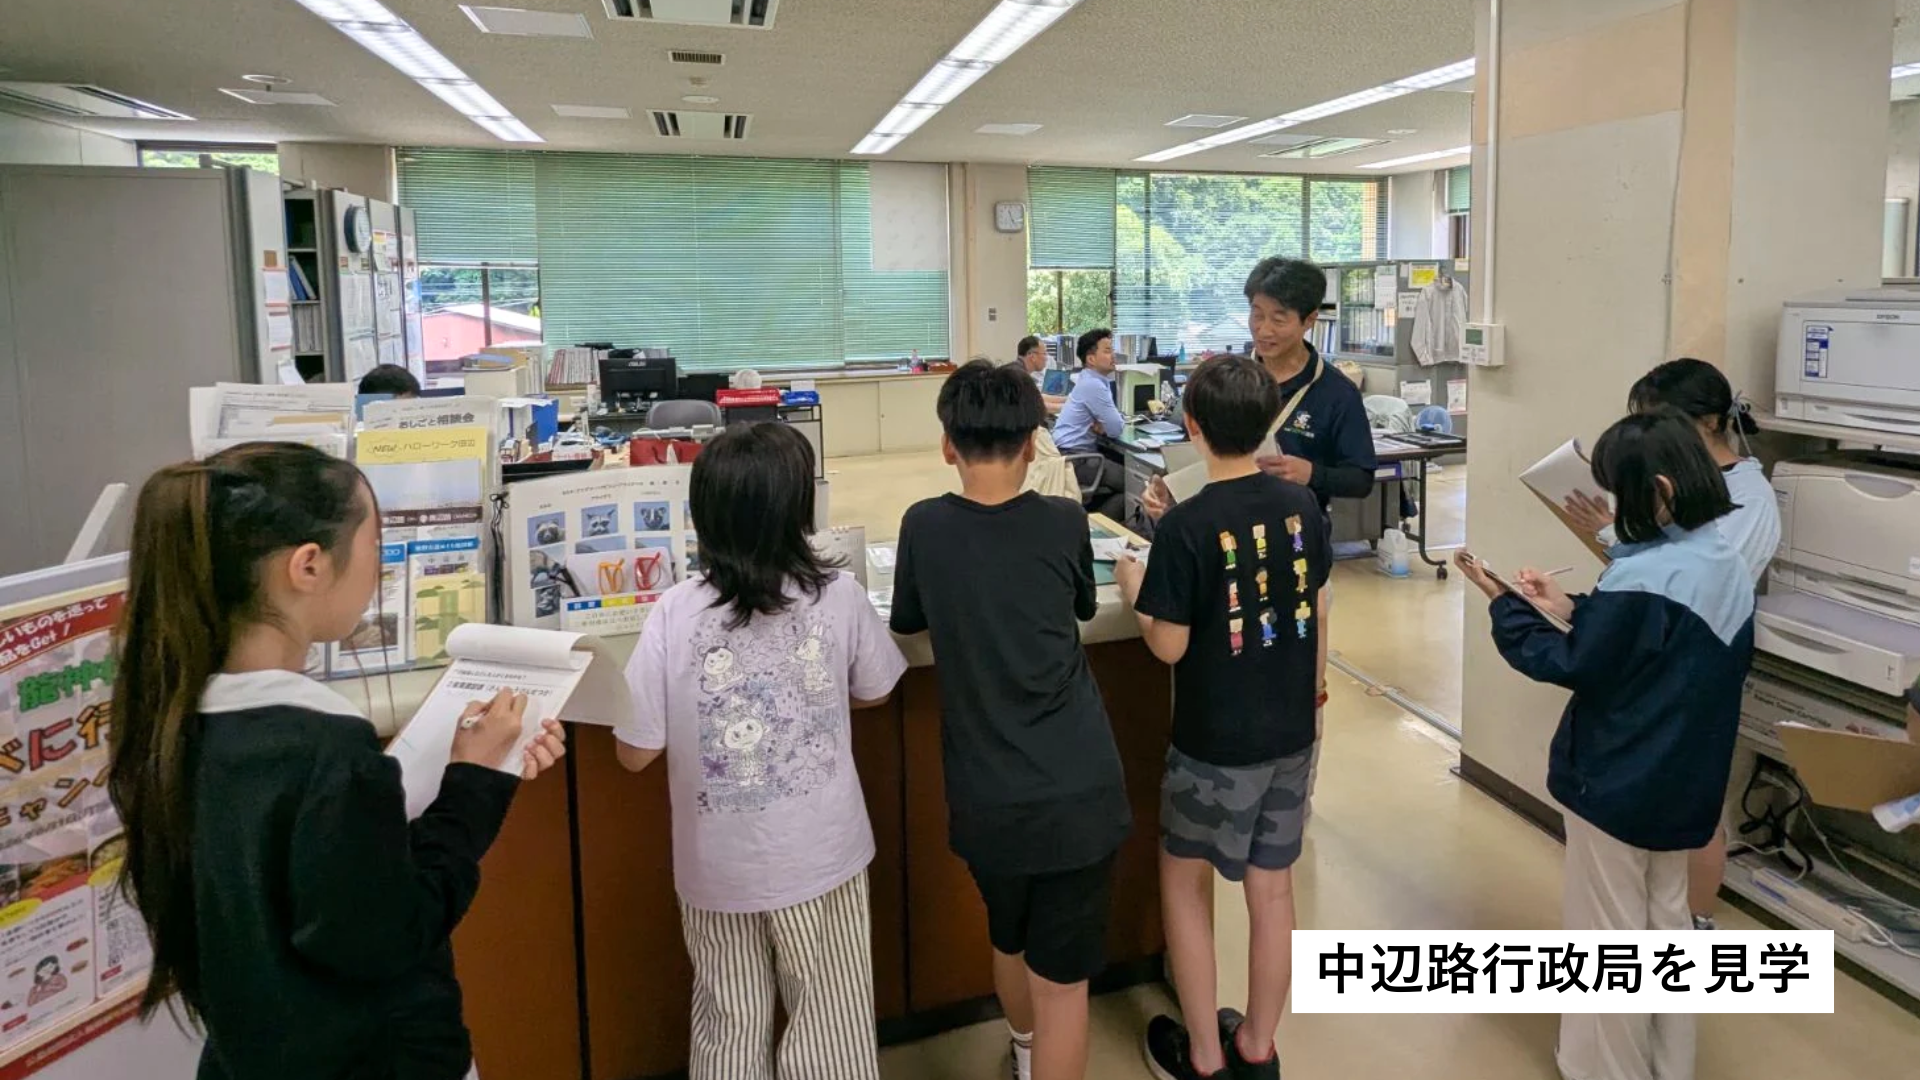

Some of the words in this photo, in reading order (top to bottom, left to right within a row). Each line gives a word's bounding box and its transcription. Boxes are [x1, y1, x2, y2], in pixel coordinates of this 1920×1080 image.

[398, 412, 475, 429] おしごと相談会
